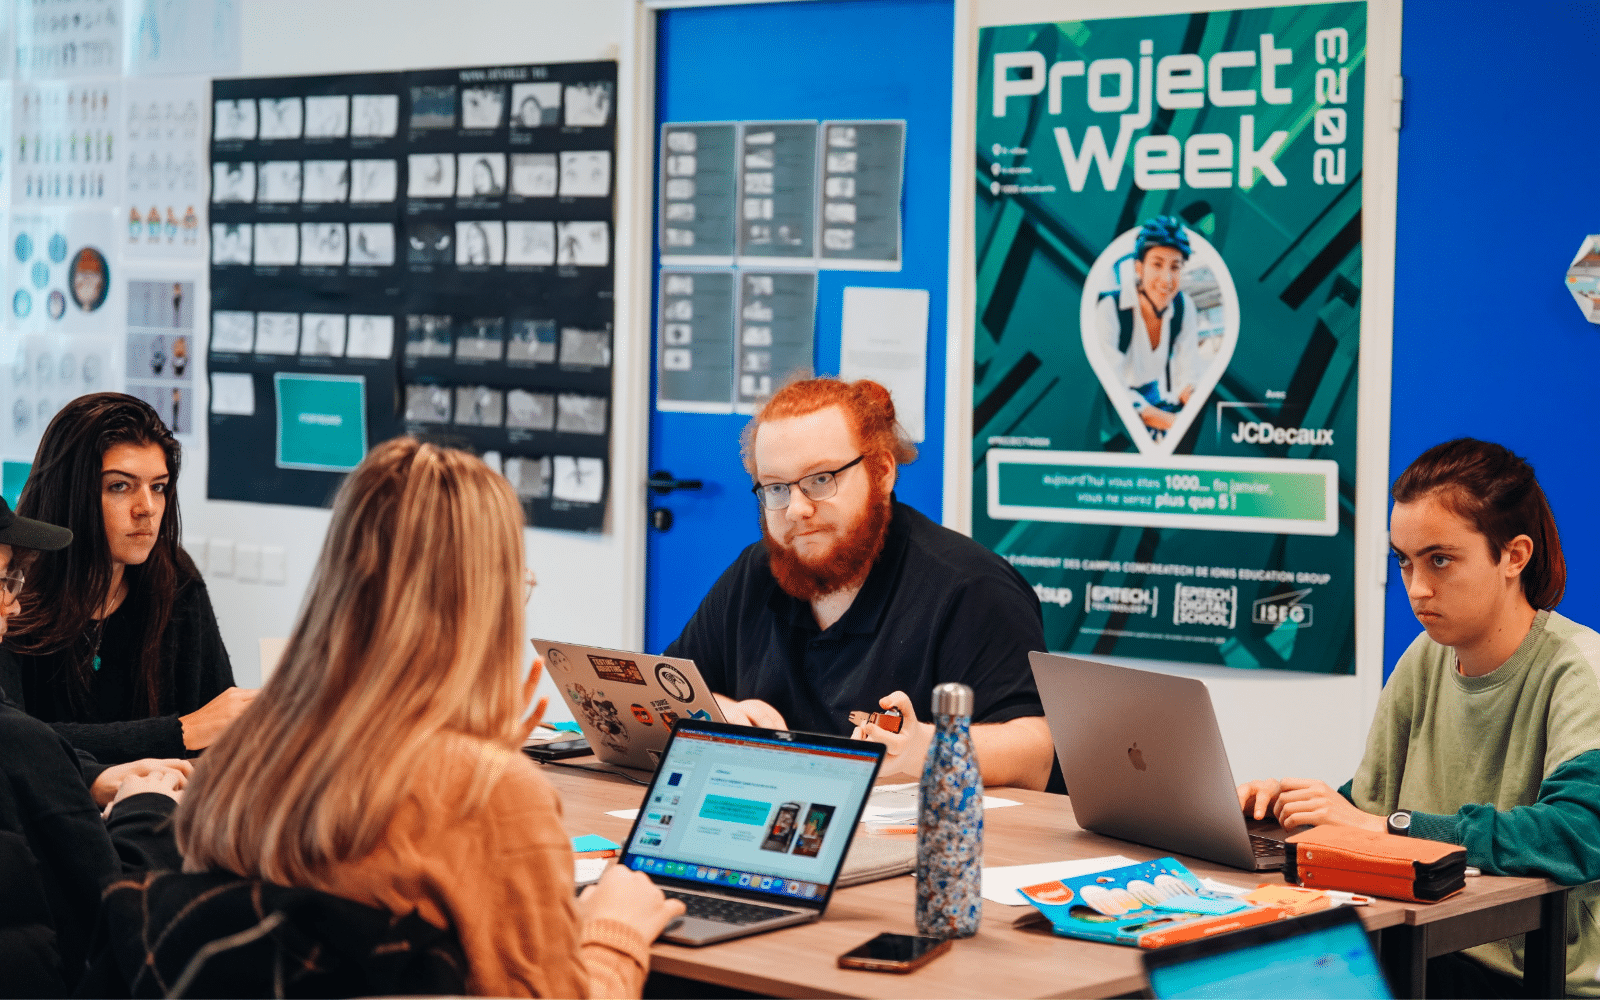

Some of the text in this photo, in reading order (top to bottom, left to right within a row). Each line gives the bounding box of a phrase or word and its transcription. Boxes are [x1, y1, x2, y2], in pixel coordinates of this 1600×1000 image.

[993, 34, 1292, 129] Project
[1313, 27, 1348, 185] 2023
[1054, 115, 1288, 192] Week
[1231, 421, 1334, 445] JCDecaux
[1108, 478, 1134, 488] vous
[1077, 492, 1103, 504] vous
[1105, 494, 1119, 504] ne
[1122, 496, 1152, 506] serez
[1154, 492, 1186, 510] plus
[1188, 496, 1216, 512] que
[1062, 557, 1081, 571] DES
[1081, 559, 1121, 573] CAMPUS
[1195, 565, 1209, 578] DE
[1209, 566, 1237, 580] IONIS
[1237, 568, 1295, 583] EDUCATION
[1295, 571, 1331, 585] GROUP
[1091, 585, 1152, 604] EPITECH
[1179, 611, 1230, 627] SCHOOL
[1260, 603, 1305, 623] ISEG
